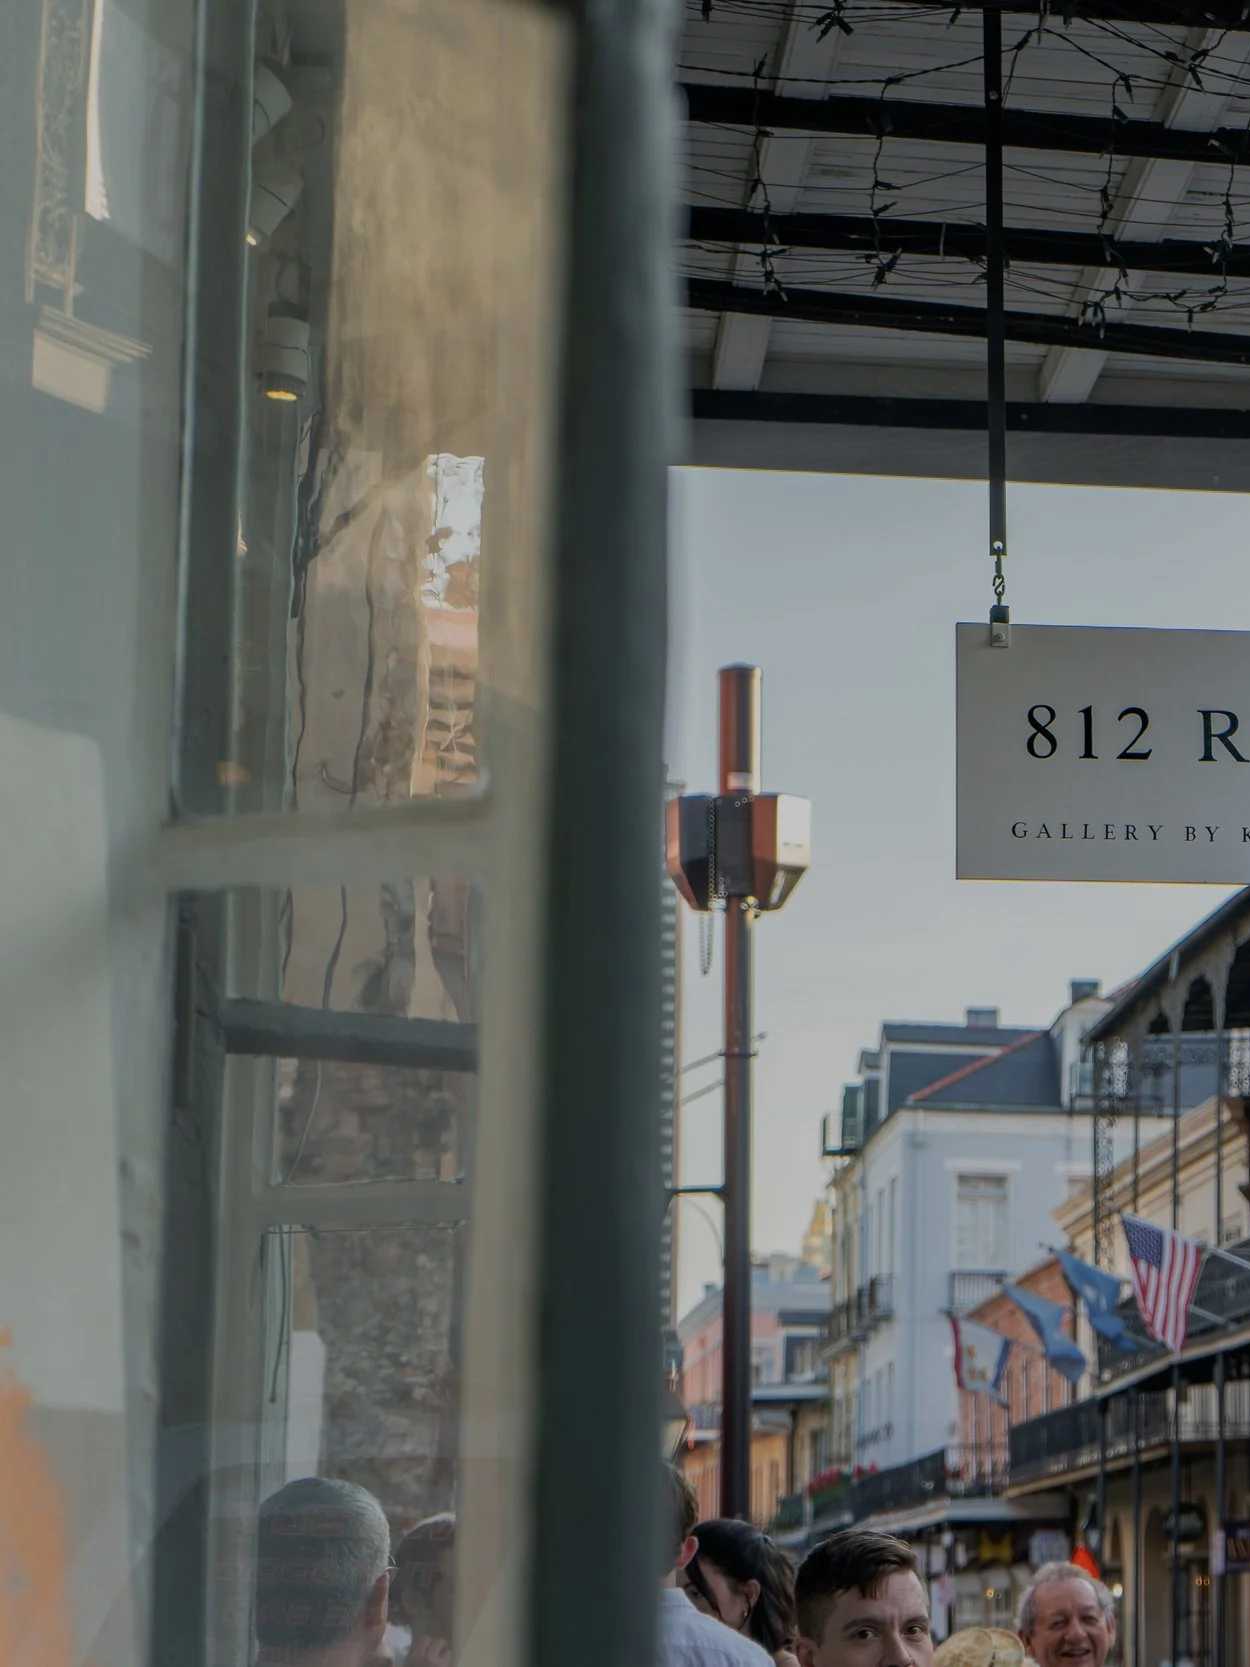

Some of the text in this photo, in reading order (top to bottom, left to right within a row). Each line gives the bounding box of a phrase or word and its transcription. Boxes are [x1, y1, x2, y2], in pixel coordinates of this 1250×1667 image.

[1026, 704, 1153, 761] 812
[1011, 821, 1164, 842] GALLERY
[1184, 825, 1220, 843] BY
